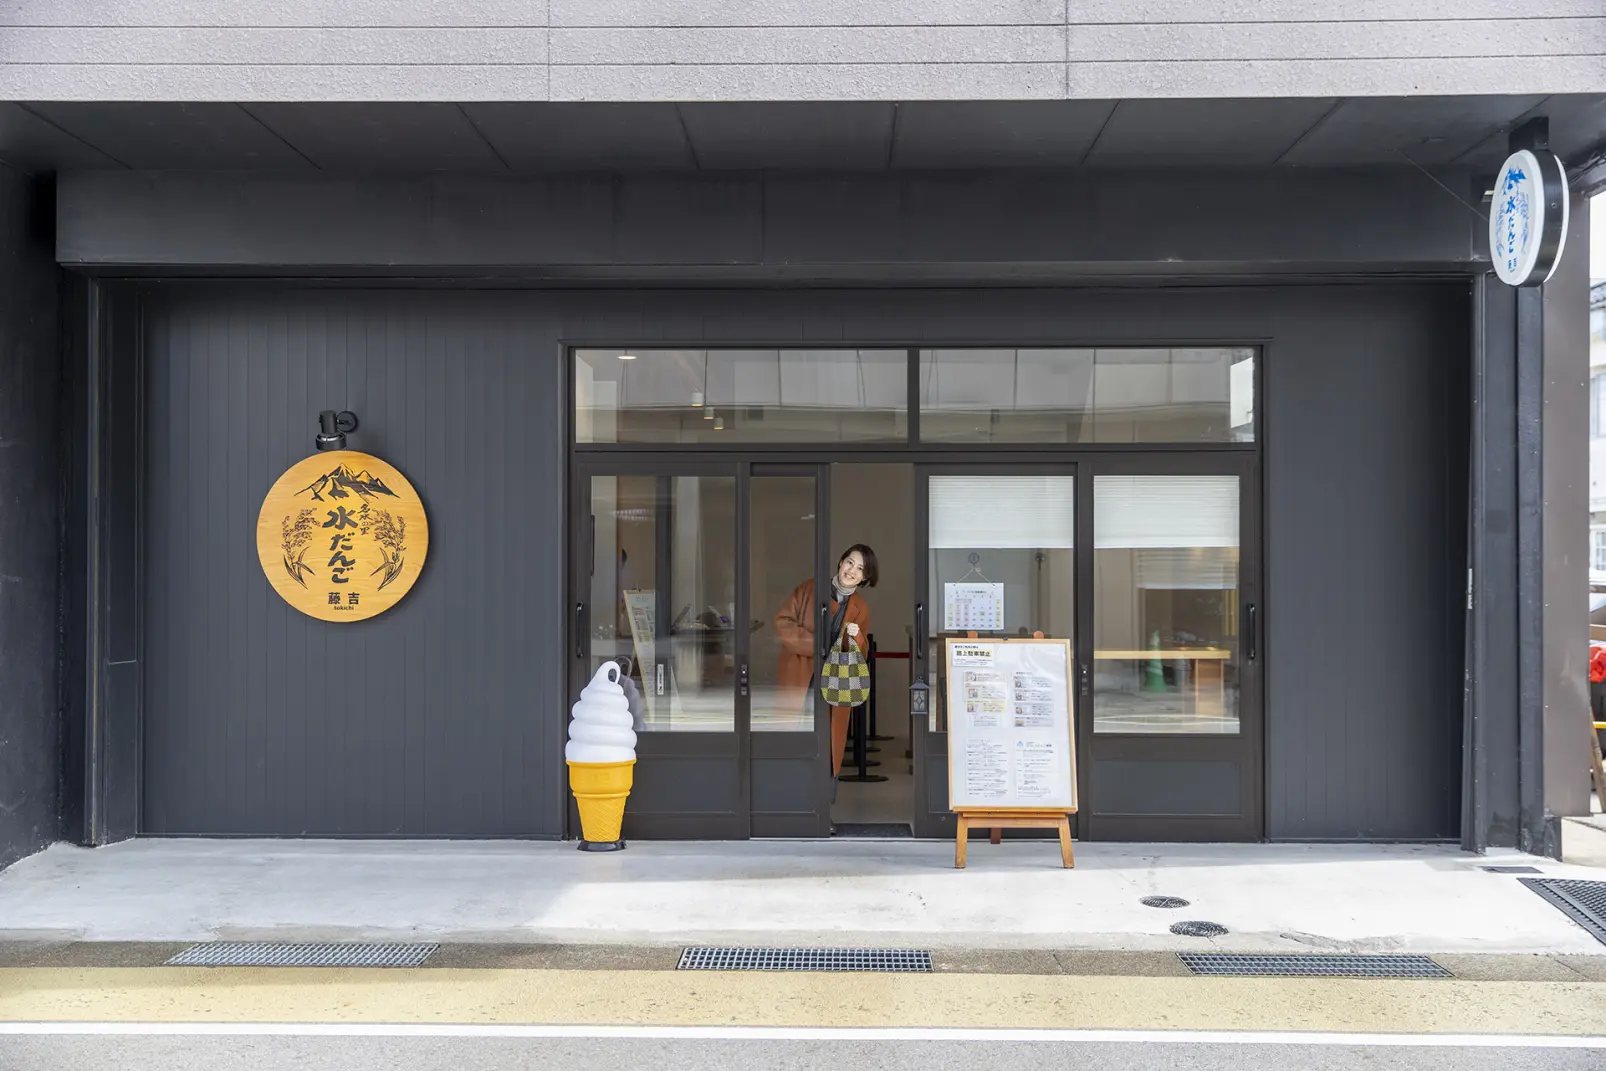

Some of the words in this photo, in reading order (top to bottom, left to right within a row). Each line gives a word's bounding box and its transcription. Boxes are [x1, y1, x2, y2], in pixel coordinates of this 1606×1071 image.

[357, 503, 373, 535] 名水の里
[322, 505, 359, 584] 水だんご
[328, 592, 360, 605] 藤吉
